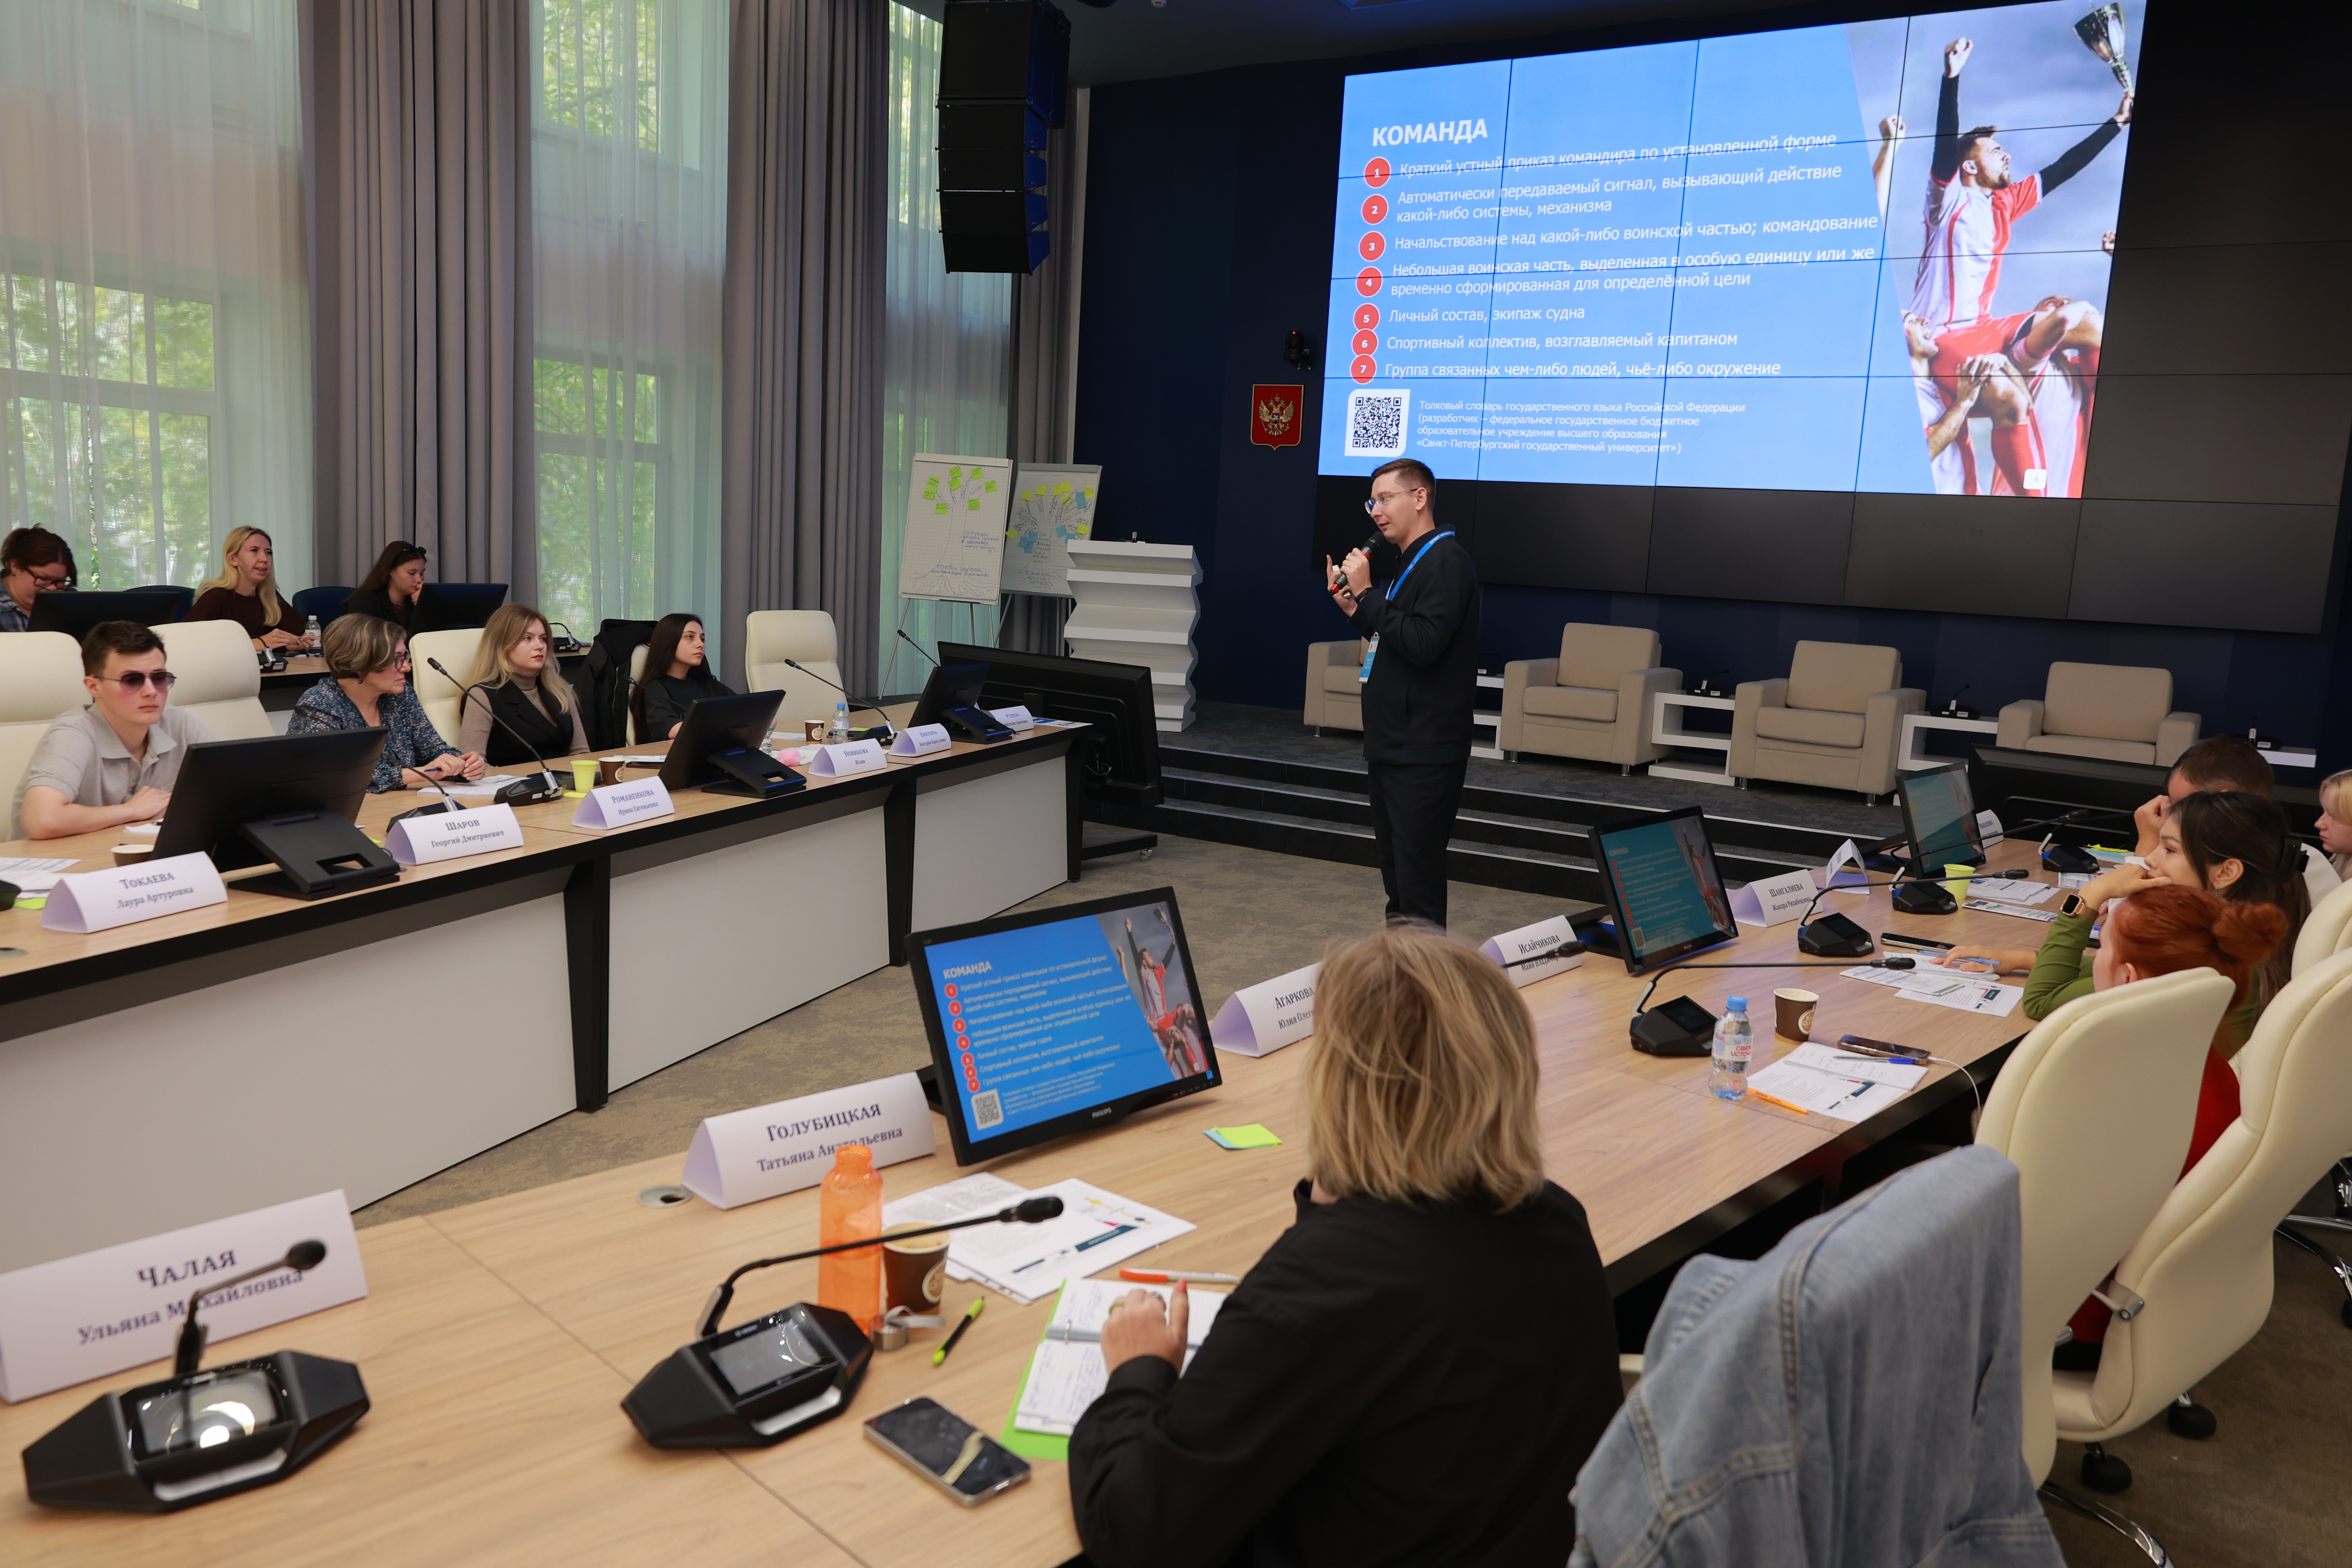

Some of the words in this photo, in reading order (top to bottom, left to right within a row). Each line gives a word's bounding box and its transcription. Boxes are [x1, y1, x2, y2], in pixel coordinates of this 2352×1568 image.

[1372, 118, 1488, 146] КОМАНДА
[1375, 168, 1381, 178] 1
[1400, 159, 1452, 179] Краткий
[1456, 156, 1503, 176] устный
[1508, 155, 1555, 172] приказ
[1559, 149, 1635, 166] командира
[1639, 147, 1658, 160] по
[1663, 135, 1778, 162] установленной
[1782, 134, 1837, 153] форме
[1397, 188, 1494, 204] Автоматически
[1498, 178, 1599, 200] передаваемый
[1603, 179, 1656, 192] сигнал,
[1662, 167, 1764, 188] вызывающий
[1767, 165, 1842, 184] действие
[1396, 206, 1469, 222] какой-либо
[1473, 205, 1532, 218] системы,
[1537, 200, 1612, 214] механизма
[1369, 242, 1375, 251] 3
[1395, 234, 1507, 249] Начальствование
[1511, 233, 1536, 245] над
[1540, 227, 1620, 243] какой-либо
[1623, 221, 1693, 239] воинской
[1697, 222, 1756, 236] частью;
[1762, 215, 1878, 233] командование
[1393, 263, 1464, 276] Небольшая
[1468, 262, 1529, 274] воинская
[1533, 260, 1574, 273] часть,
[1580, 256, 1667, 272] выделенная
[1670, 256, 1681, 266] в
[1685, 251, 1741, 269] особую
[1745, 251, 1812, 266] единицу
[1816, 249, 1846, 261] или
[1851, 248, 1874, 260] же
[1391, 284, 1452, 297] временно
[1455, 280, 1570, 296] сформированная
[1573, 279, 1599, 292] для
[1603, 271, 1709, 292] определённой
[1714, 274, 1750, 287] цели
[1363, 314, 1370, 323] 5
[1388, 308, 1438, 322] Личный
[1441, 310, 1487, 323] состав,
[1492, 309, 1542, 320] экипаж
[1545, 308, 1585, 322] судна
[1362, 340, 1368, 348] 6
[1387, 335, 1464, 351] Спортивный
[1468, 337, 1540, 350] коллектив,
[1545, 332, 1653, 347] возглавляемый
[1657, 334, 1737, 346] капитаном
[1360, 365, 1367, 374] 7
[1385, 363, 1428, 377] Группа
[1432, 365, 1500, 375] связанных
[1504, 362, 1568, 375] чем-либо
[1571, 361, 1621, 377] людей,
[1626, 361, 1693, 375] чьё-либо
[1697, 363, 1781, 377] окружение
[1420, 401, 1463, 410] Толковый
[1465, 403, 1503, 413] словарь
[1505, 403, 1590, 413] государственного
[1625, 401, 1684, 412] Российской
[1686, 402, 1746, 414] Федерации
[1418, 413, 1478, 424] (разработчик
[1489, 414, 1553, 426] федеральное
[1555, 416, 1638, 427] государственное
[1640, 416, 1700, 427] бюджетное
[1417, 425, 1495, 436] образовательное
[1498, 429, 1555, 438] учреждение
[1602, 428, 1667, 440] образования
[1417, 438, 1520, 450] «Санкт-Петербургский
[1522, 441, 1605, 452] государственный
[1607, 442, 1682, 454] университет»)
[843, 748, 869, 757] НОВИКОВА
[611, 789, 655, 804] РОМАНЕНКОВА
[445, 819, 480, 831] ШАРОВ
[431, 836, 461, 848] Георгий
[462, 830, 505, 844] Дмитриевич
[119, 872, 175, 890] ТОКАЕВА
[1768, 883, 1804, 897] ШАНГАЛИЕВА
[1518, 934, 1561, 954] ИСАЙЧИКОВА
[943, 961, 992, 980] КОМАНДА
[1275, 987, 1315, 1009] АГАРКОВА
[1278, 1016, 1297, 1029] Юлия
[766, 1103, 882, 1142] ГОЛУБИЦКАЯ
[757, 1150, 815, 1173] Татьяна
[138, 1249, 238, 1288] ЧАЛАЯ
[77, 1311, 161, 1344] Ульяна
[167, 1269, 304, 1320] Мхайловна
